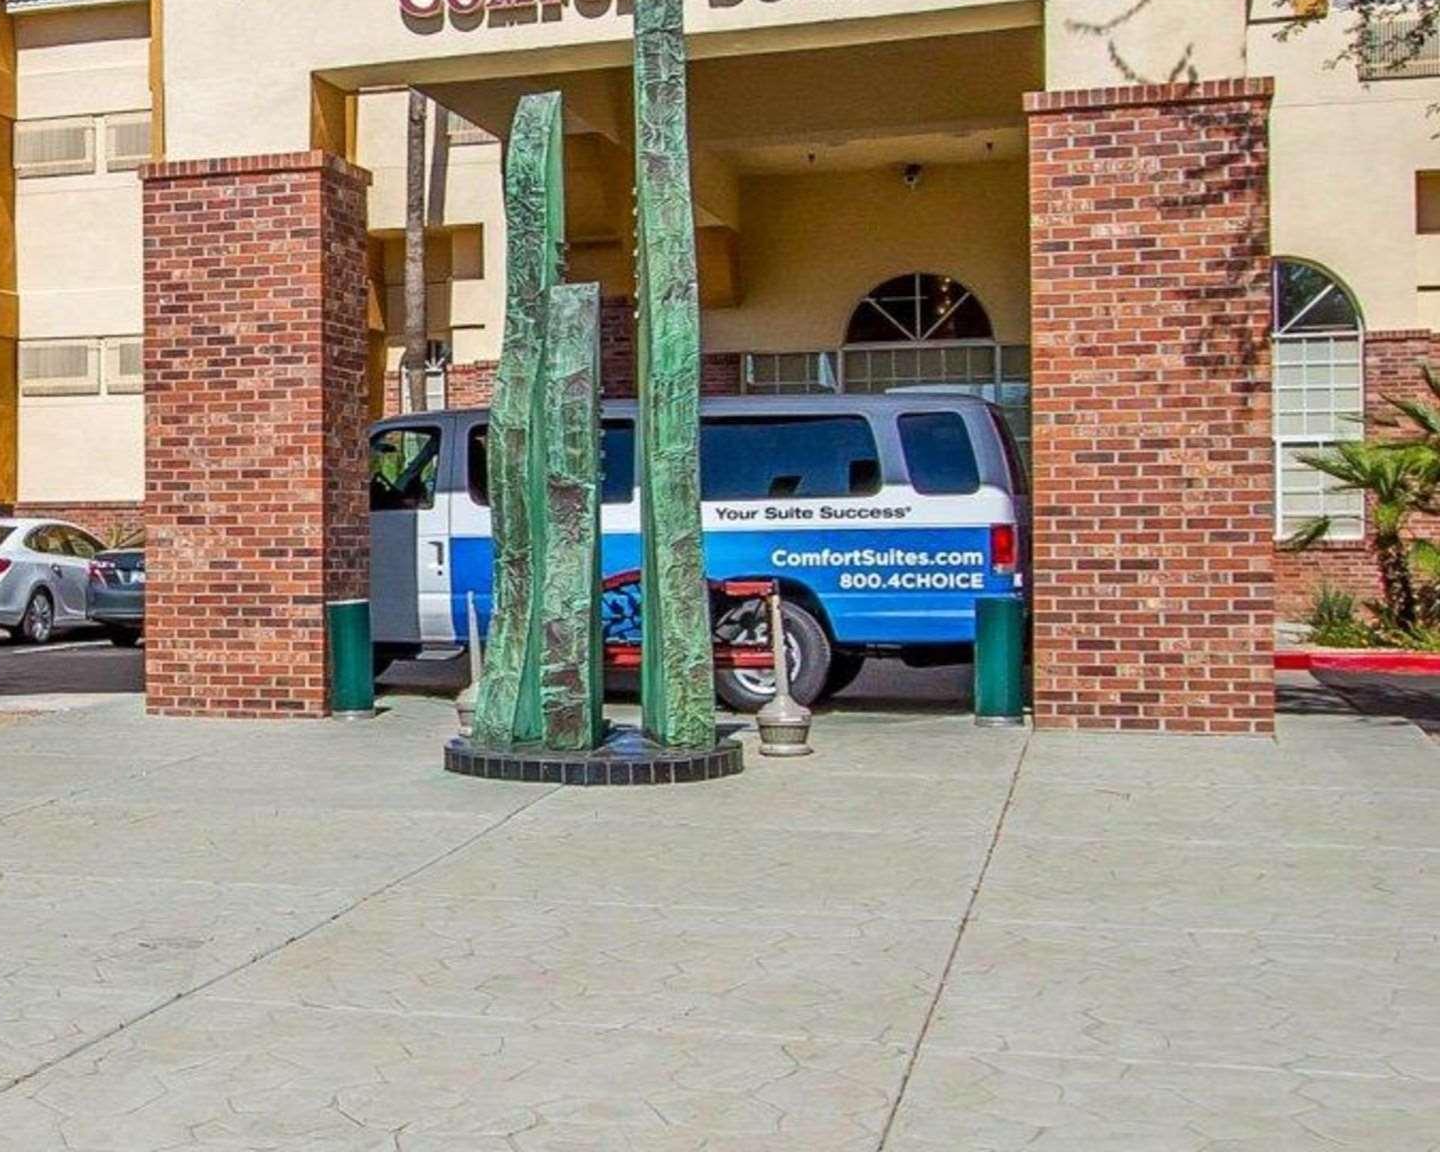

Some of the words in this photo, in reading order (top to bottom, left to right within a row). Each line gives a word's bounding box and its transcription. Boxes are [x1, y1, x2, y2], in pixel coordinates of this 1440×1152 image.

[715, 506, 758, 521] Your
[765, 506, 813, 520] Suite
[771, 548, 984, 567] ComfortSuites.com
[839, 572, 985, 589] 800.4CHOICE
